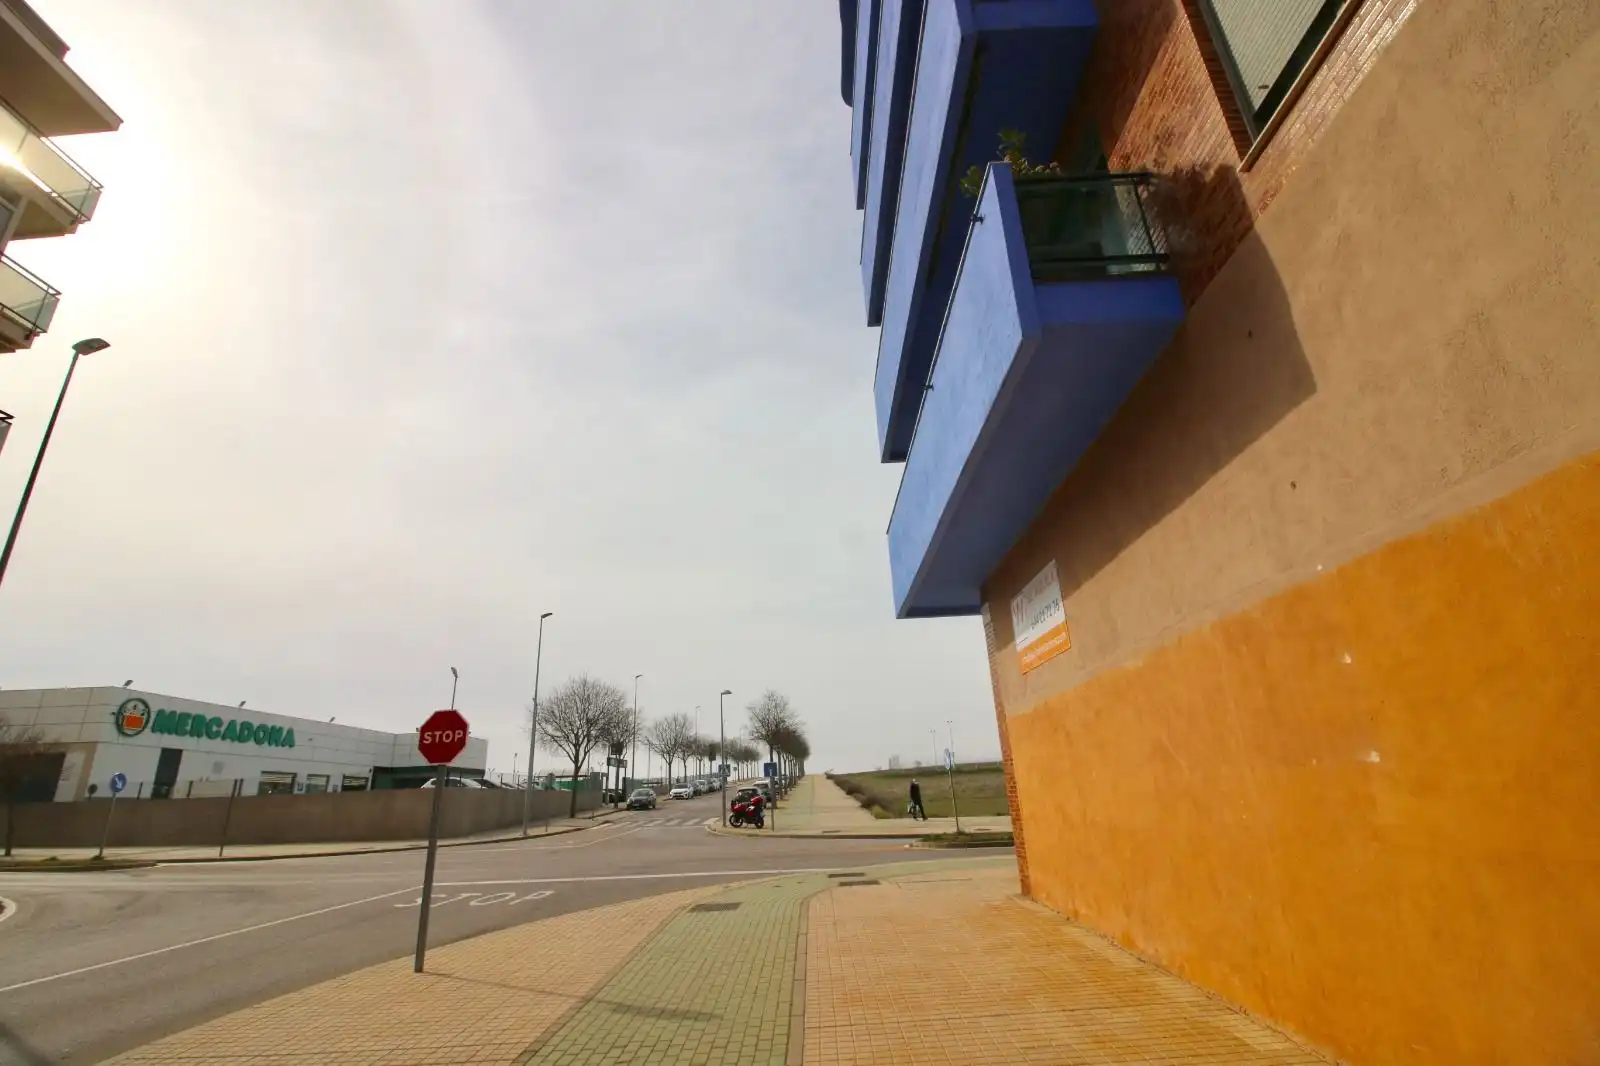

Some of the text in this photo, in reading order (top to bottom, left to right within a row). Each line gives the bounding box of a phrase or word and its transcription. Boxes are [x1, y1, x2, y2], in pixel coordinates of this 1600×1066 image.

[151, 708, 296, 748] MERCADONA
[423, 729, 464, 744] STOP
[394, 890, 555, 908] STOP
